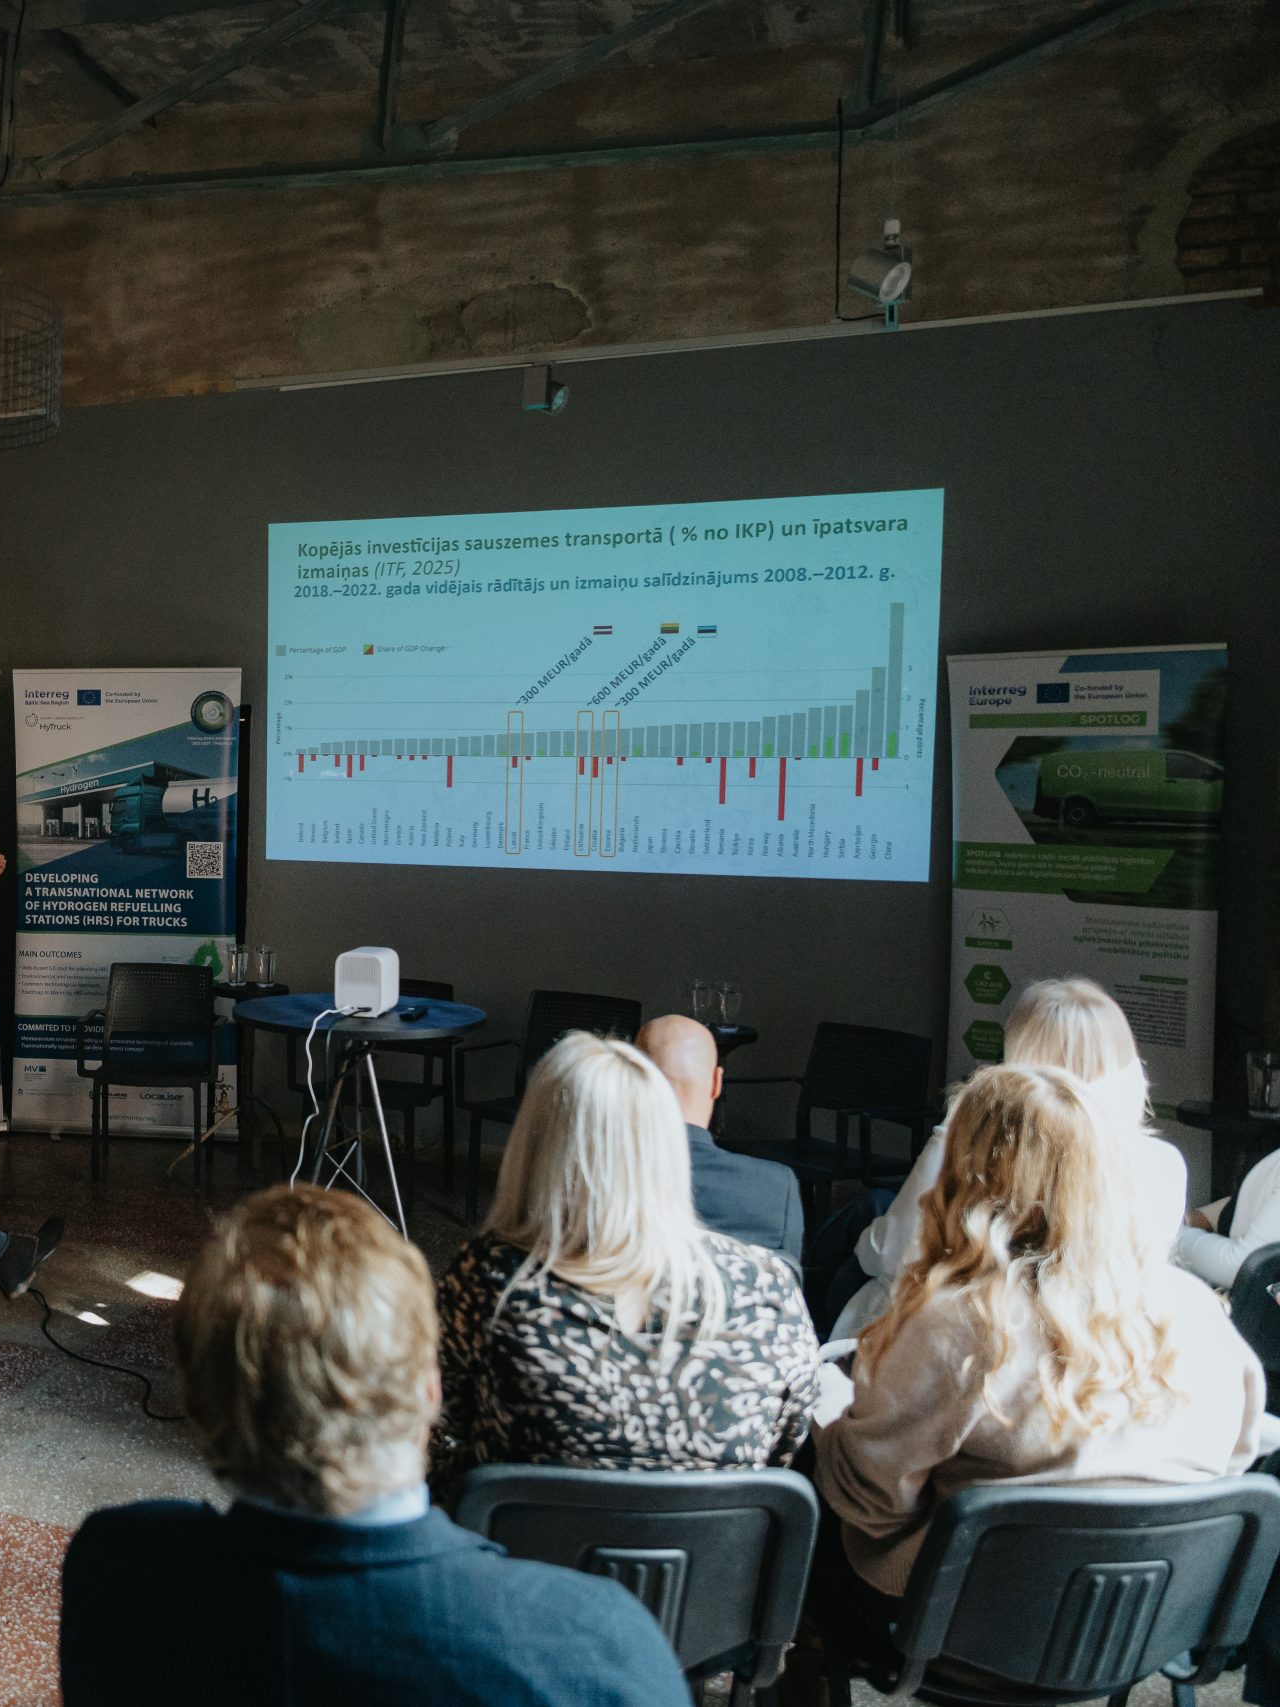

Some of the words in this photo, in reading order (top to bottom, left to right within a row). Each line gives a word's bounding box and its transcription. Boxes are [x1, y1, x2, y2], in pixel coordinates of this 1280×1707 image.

[297, 541, 362, 560] Kopējās
[367, 537, 460, 556] investīcijas
[464, 533, 559, 552] sauszemes
[564, 527, 662, 548] transportā
[681, 526, 698, 543] %
[704, 527, 729, 541] no
[735, 520, 775, 541] IKP)
[781, 522, 806, 537] un
[813, 517, 909, 539] īpatsvara
[297, 564, 370, 582] izmaiņas
[374, 561, 406, 580] (ITF,
[412, 558, 461, 577] 2025)
[385, 581, 421, 599] gada
[425, 578, 483, 596] vidējais
[487, 577, 545, 594] rādītājs
[550, 579, 570, 591] un
[575, 574, 639, 592] izmaiņu
[643, 570, 759, 588] salīdzinājums
[879, 567, 896, 582] g.
[289, 647, 324, 655] Percentage
[420, 645, 446, 654] Change
[538, 635, 594, 688] MEUR/gadā
[609, 636, 667, 690] MEUR/gadā
[638, 637, 697, 691] MEUR/gadā
[969, 685, 1027, 697] Interreg
[1074, 684, 1113, 692] Co-funded
[1114, 684, 1124, 692] by
[25, 689, 70, 701] Interreg
[969, 696, 1012, 707] Europe
[1074, 693, 1086, 701] the
[1087, 693, 1124, 701] European
[1080, 713, 1140, 725] SPOTLOG
[39, 723, 72, 732] HyTruck
[59, 778, 100, 796] Hydrogen
[471, 821, 479, 848] Germany
[762, 831, 770, 857] Norway
[776, 833, 784, 858] Albania
[792, 829, 800, 858] Australia
[823, 830, 832, 859] Hungary
[25, 872, 99, 884] DEVELOPING
[25, 887, 33, 897] A
[35, 887, 133, 899] TRANSNATIONAL
[135, 888, 195, 900] NETWORK
[25, 900, 40, 910] OF
[42, 901, 108, 912] HYDROGEN
[111, 902, 182, 913] REFUELLING
[25, 914, 80, 925] STATIONS
[83, 915, 113, 927] (HRS)
[116, 916, 140, 926] FOR
[142, 917, 188, 928] TRUCKS
[18, 950, 38, 958] MAIN
[39, 950, 83, 959] OUTCOMES
[17, 1023, 60, 1032] COMMITED
[61, 1024, 71, 1032] TO
